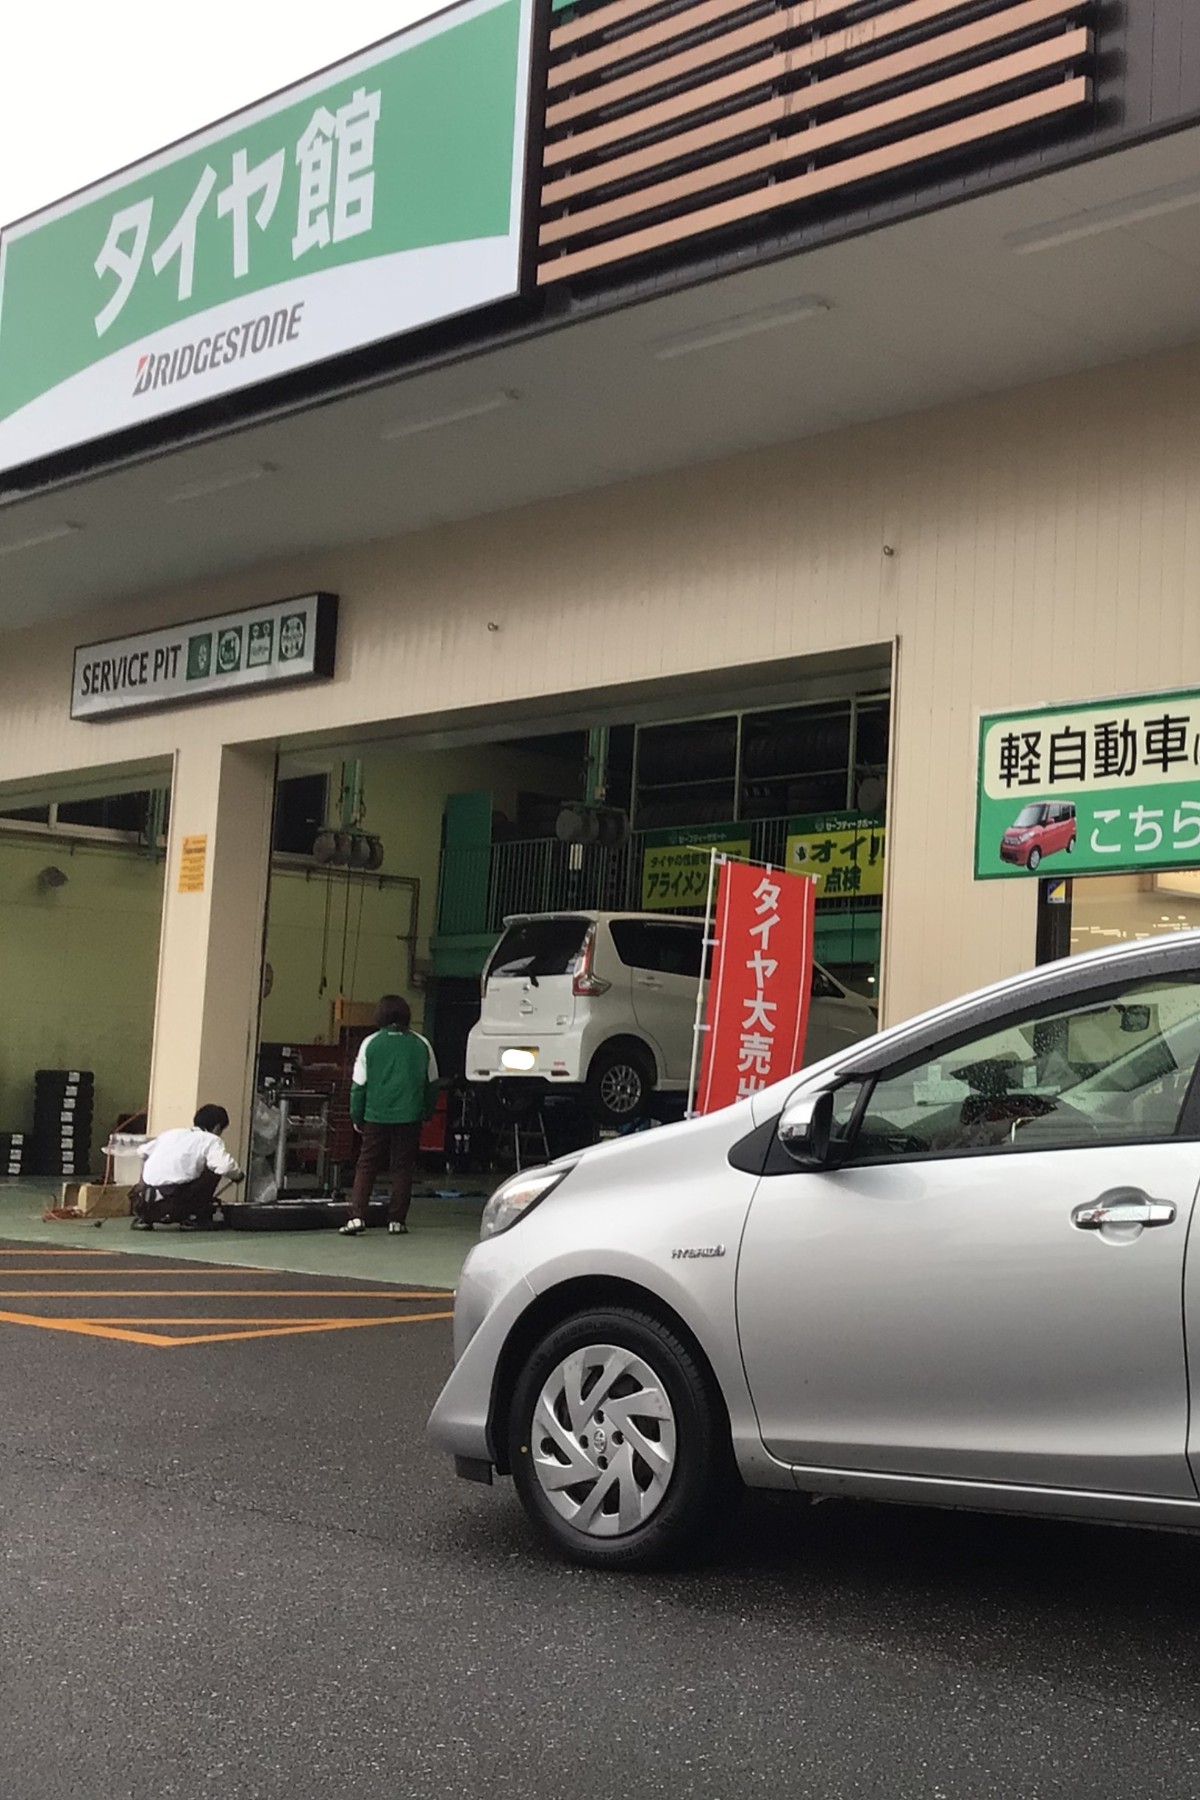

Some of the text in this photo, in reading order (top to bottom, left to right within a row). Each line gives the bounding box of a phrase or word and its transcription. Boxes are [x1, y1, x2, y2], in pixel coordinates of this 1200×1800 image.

[94, 86, 382, 338] タイヤ館
[132, 302, 305, 397] BRIDGESTONE
[81, 644, 182, 696] SERVICE PIT
[647, 869, 716, 899] アライメン
[824, 865, 862, 893] 点検
